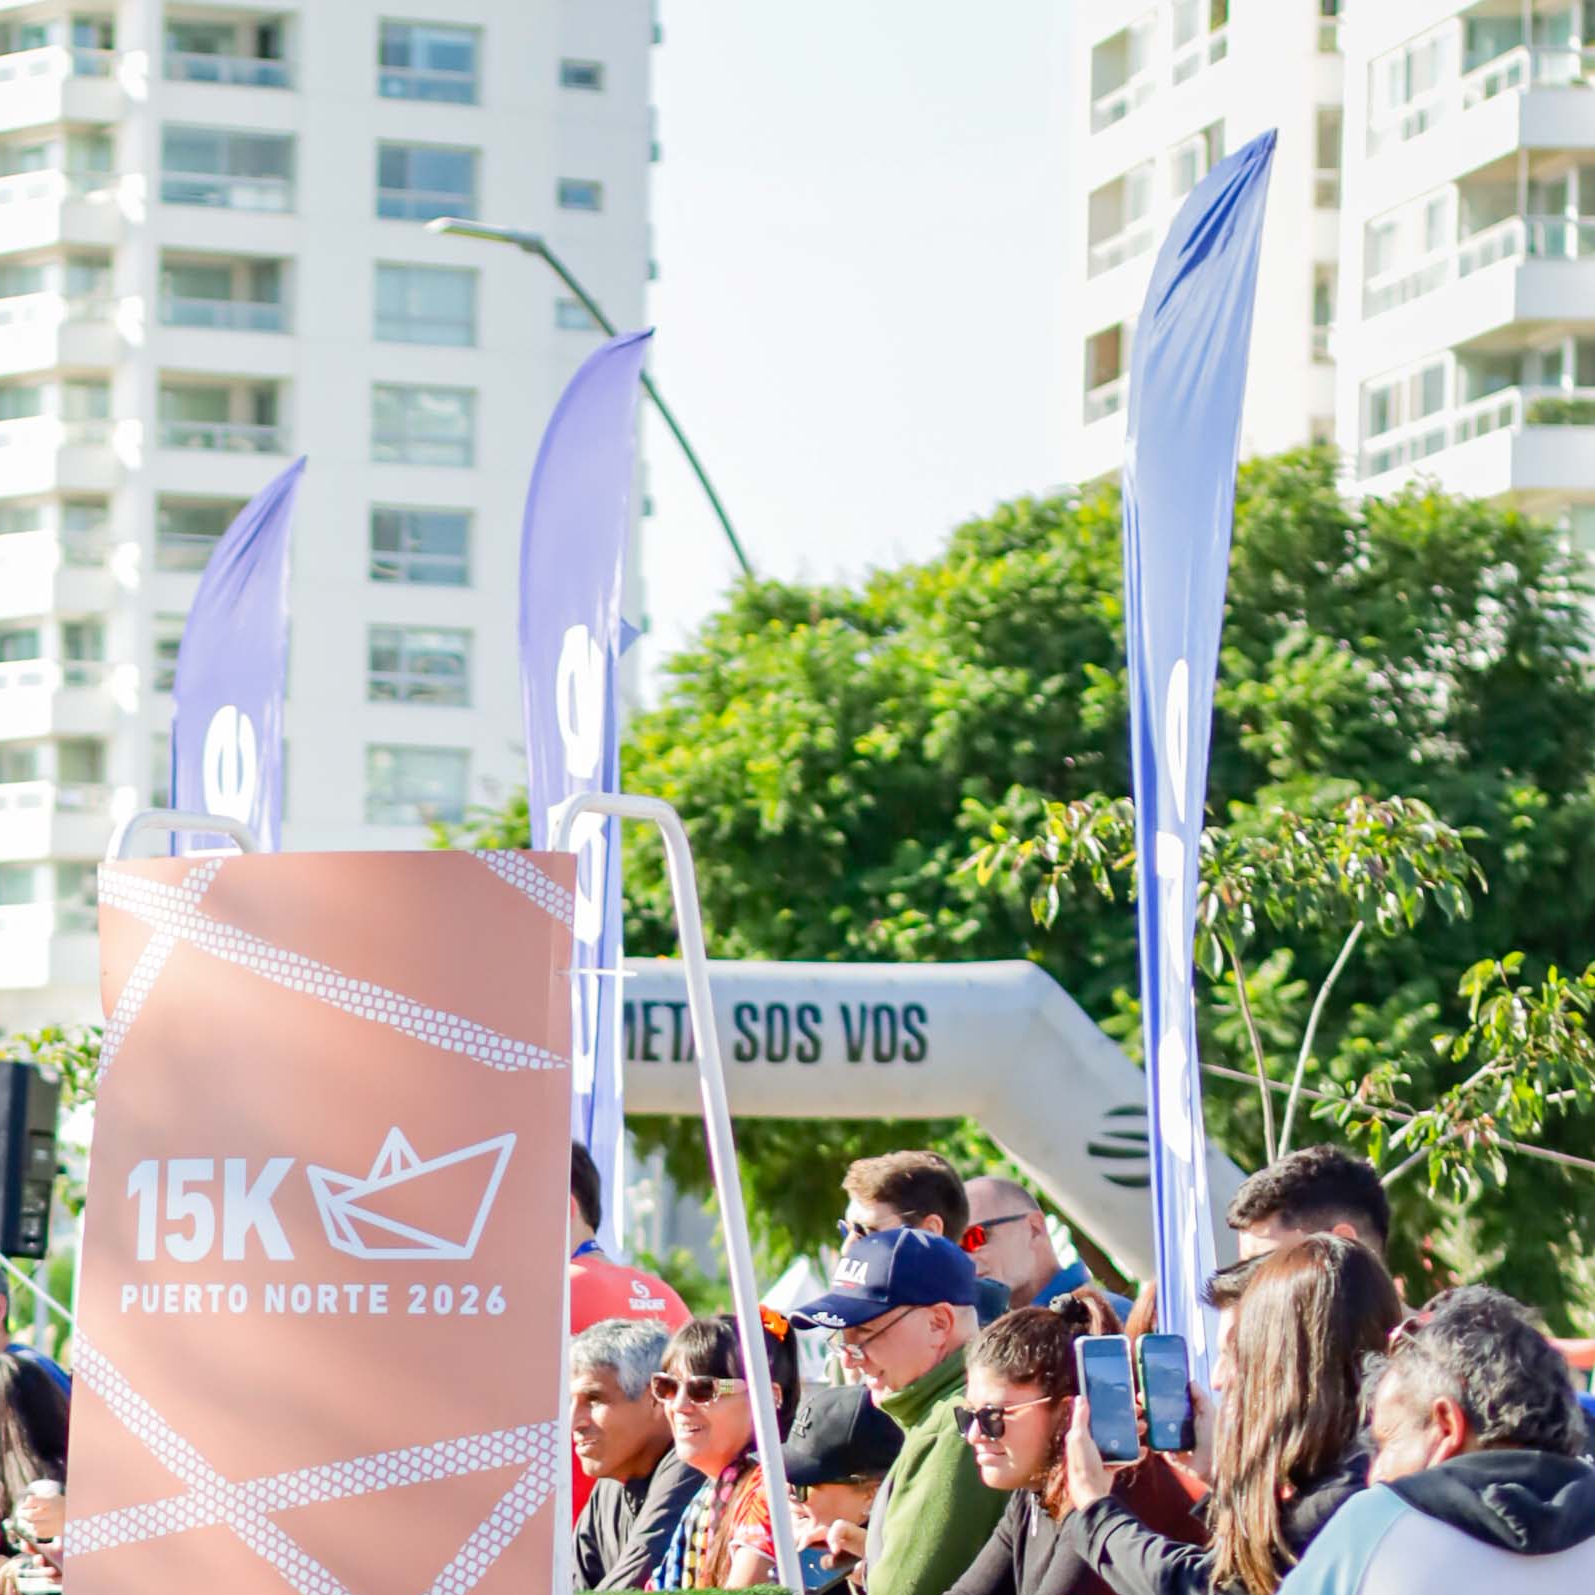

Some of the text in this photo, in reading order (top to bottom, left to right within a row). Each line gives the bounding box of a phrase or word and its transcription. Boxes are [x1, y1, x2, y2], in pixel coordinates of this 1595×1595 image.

[733, 1001, 823, 1065] SOS
[840, 1002, 928, 1065] VOS
[126, 1157, 295, 1262] 15K
[121, 1284, 507, 1315] PUERTO NORTE 2026
